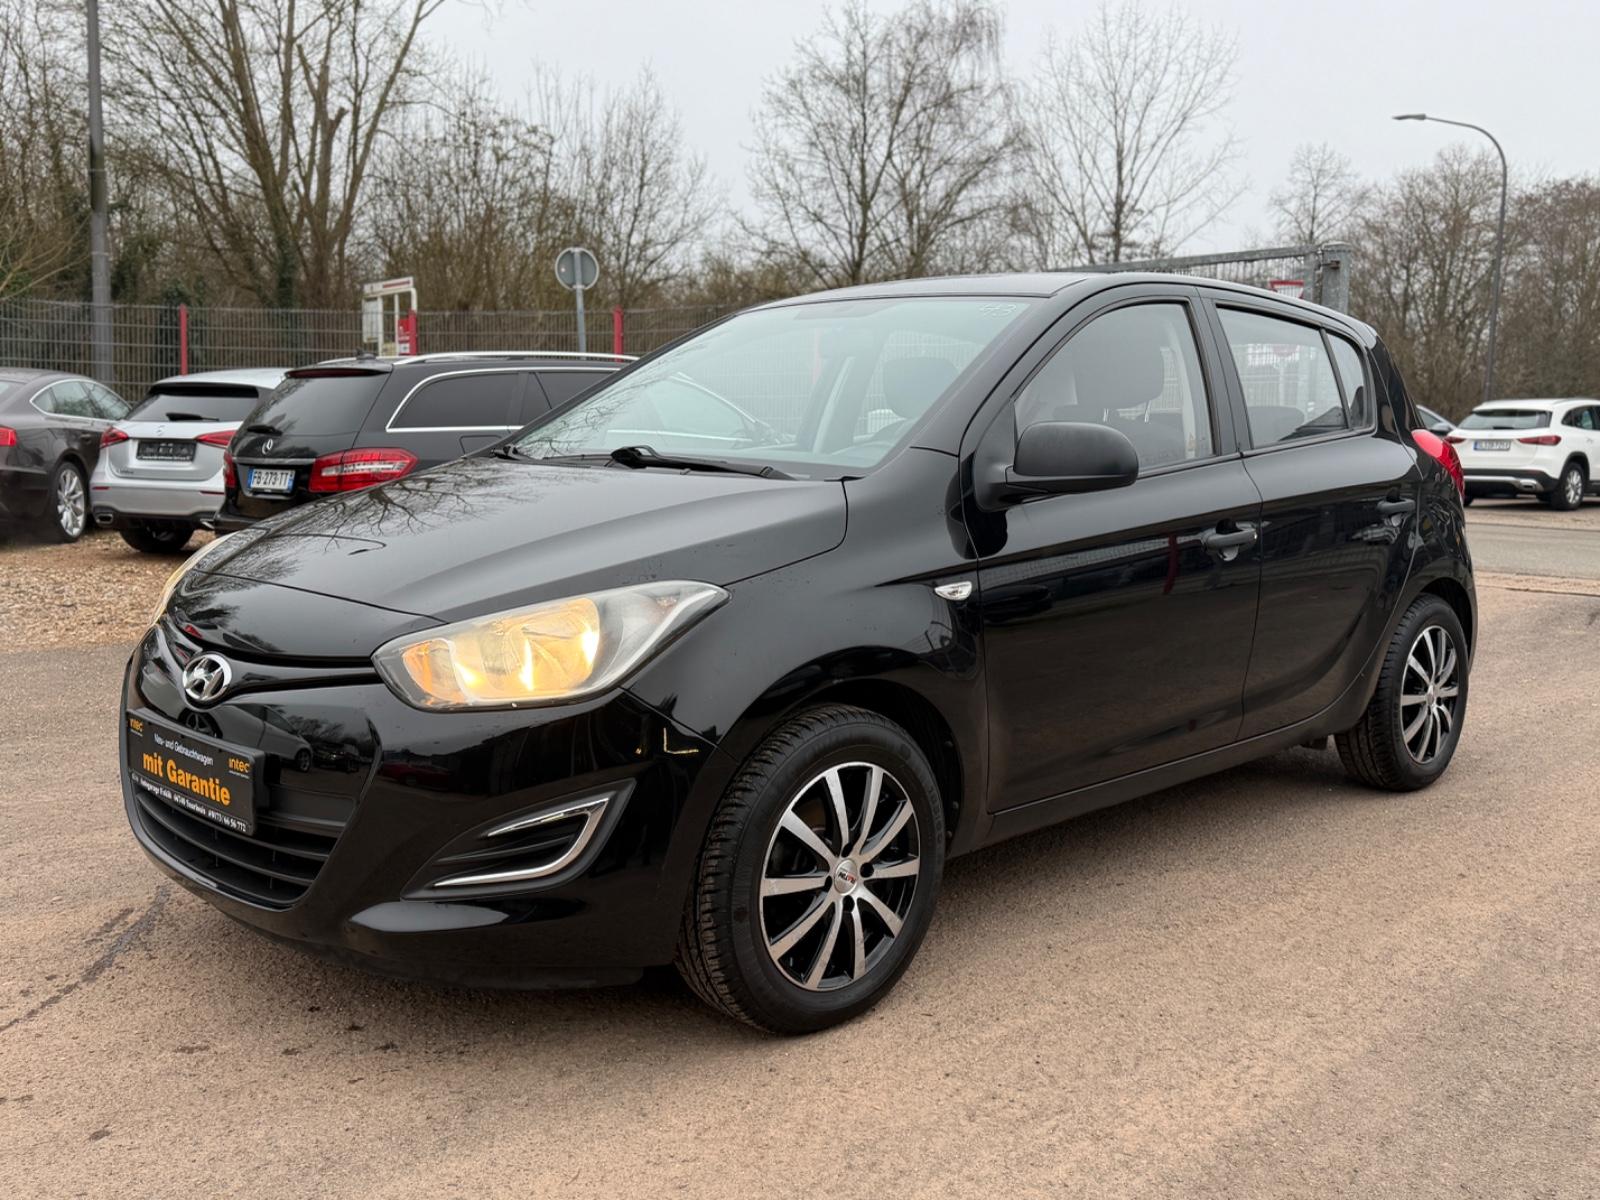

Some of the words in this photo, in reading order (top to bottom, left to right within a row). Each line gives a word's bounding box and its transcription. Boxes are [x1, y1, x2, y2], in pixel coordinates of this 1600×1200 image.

[142, 752, 163, 777] mit
[166, 759, 231, 806] Garantie
[228, 757, 250, 774] intec
